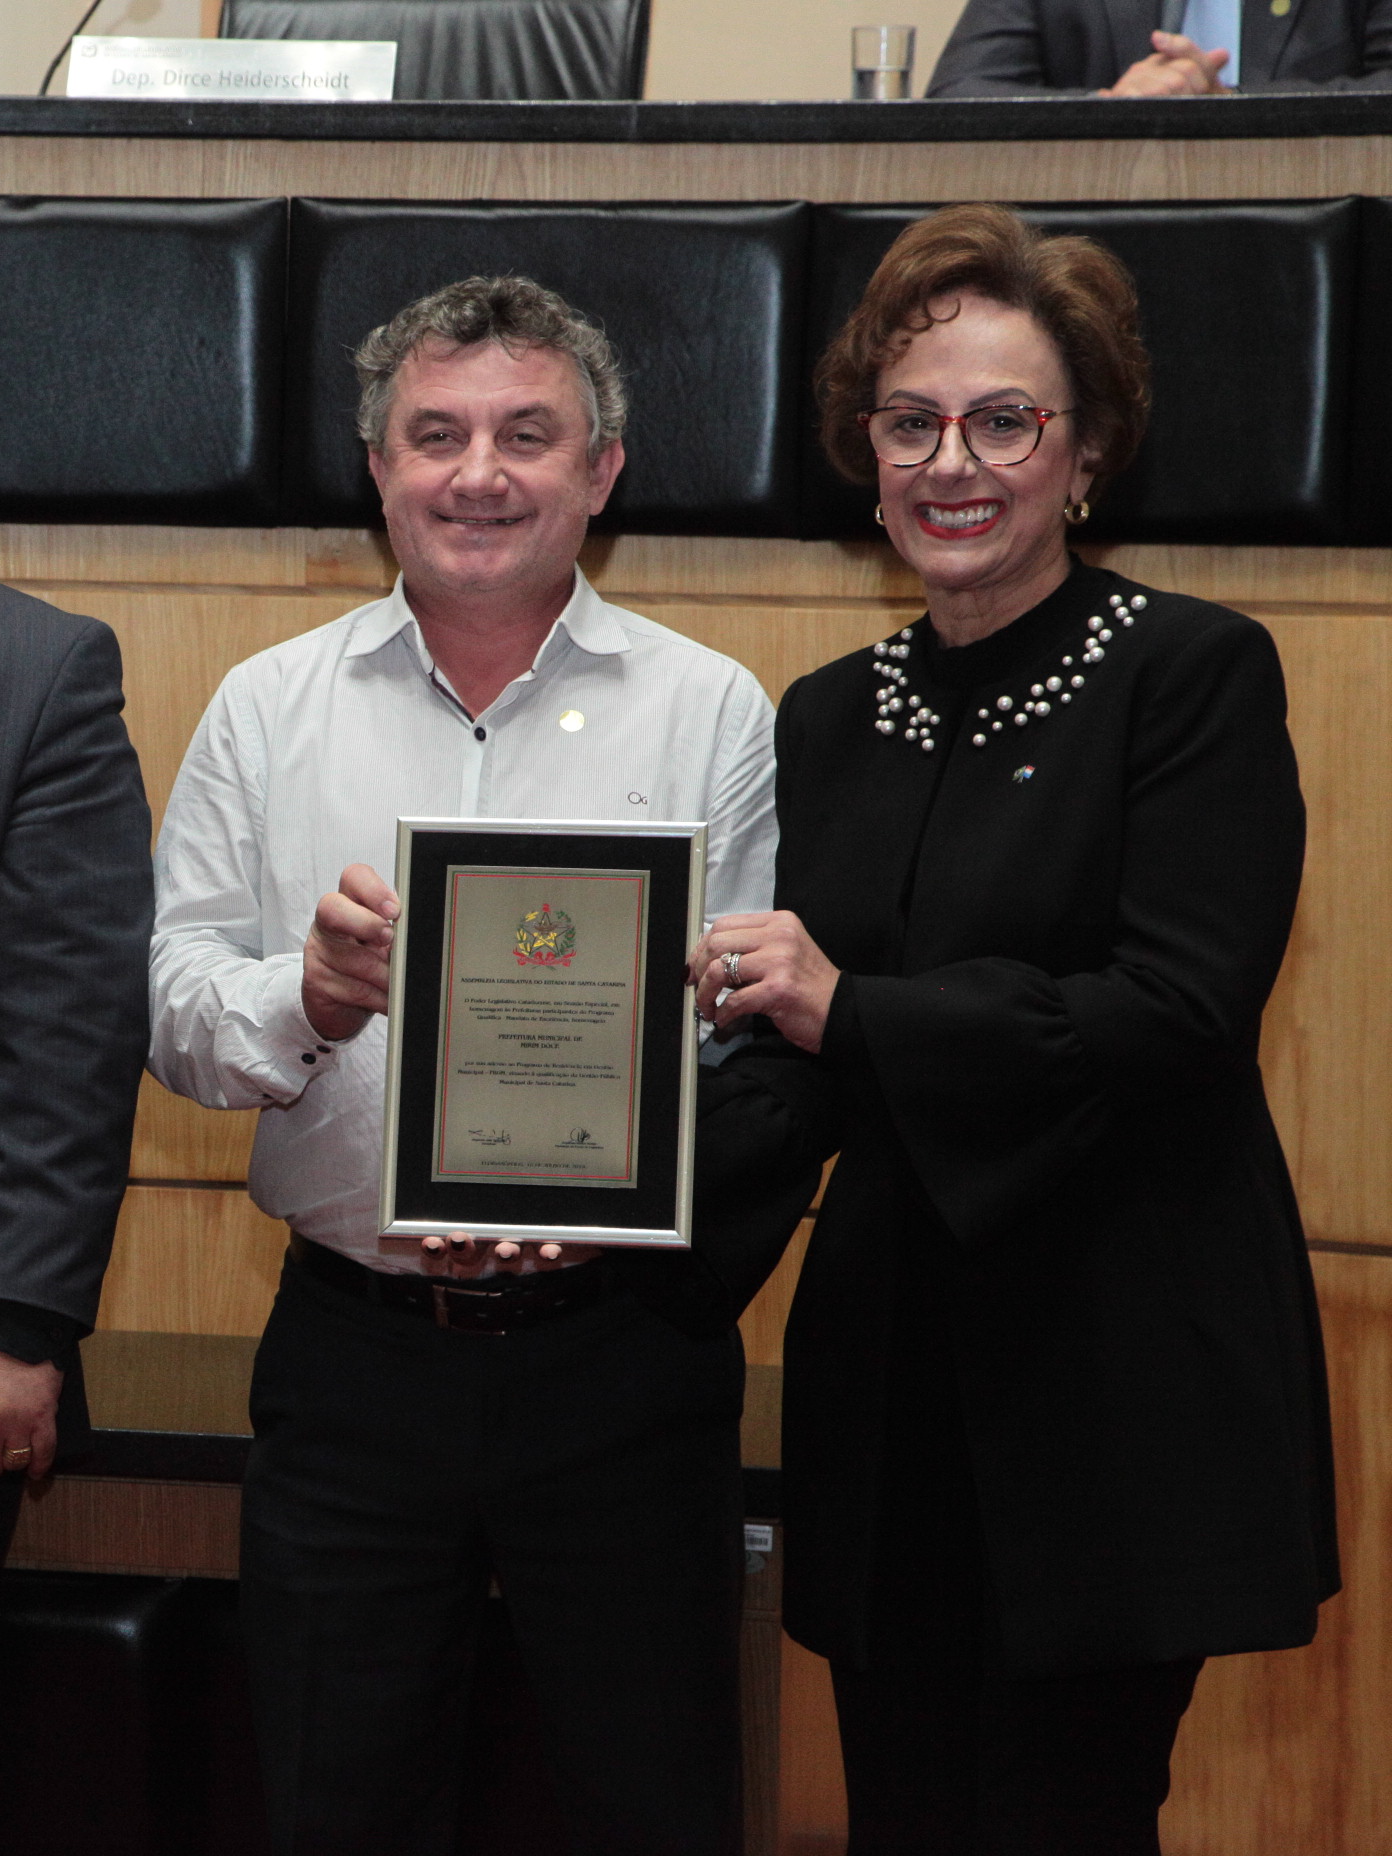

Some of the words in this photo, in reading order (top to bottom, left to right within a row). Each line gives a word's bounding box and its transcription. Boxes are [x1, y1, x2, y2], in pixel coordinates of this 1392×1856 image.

[111, 67, 154, 87] Dep.
[163, 69, 211, 87] Dirce
[218, 70, 349, 90] Heiderscheidt
